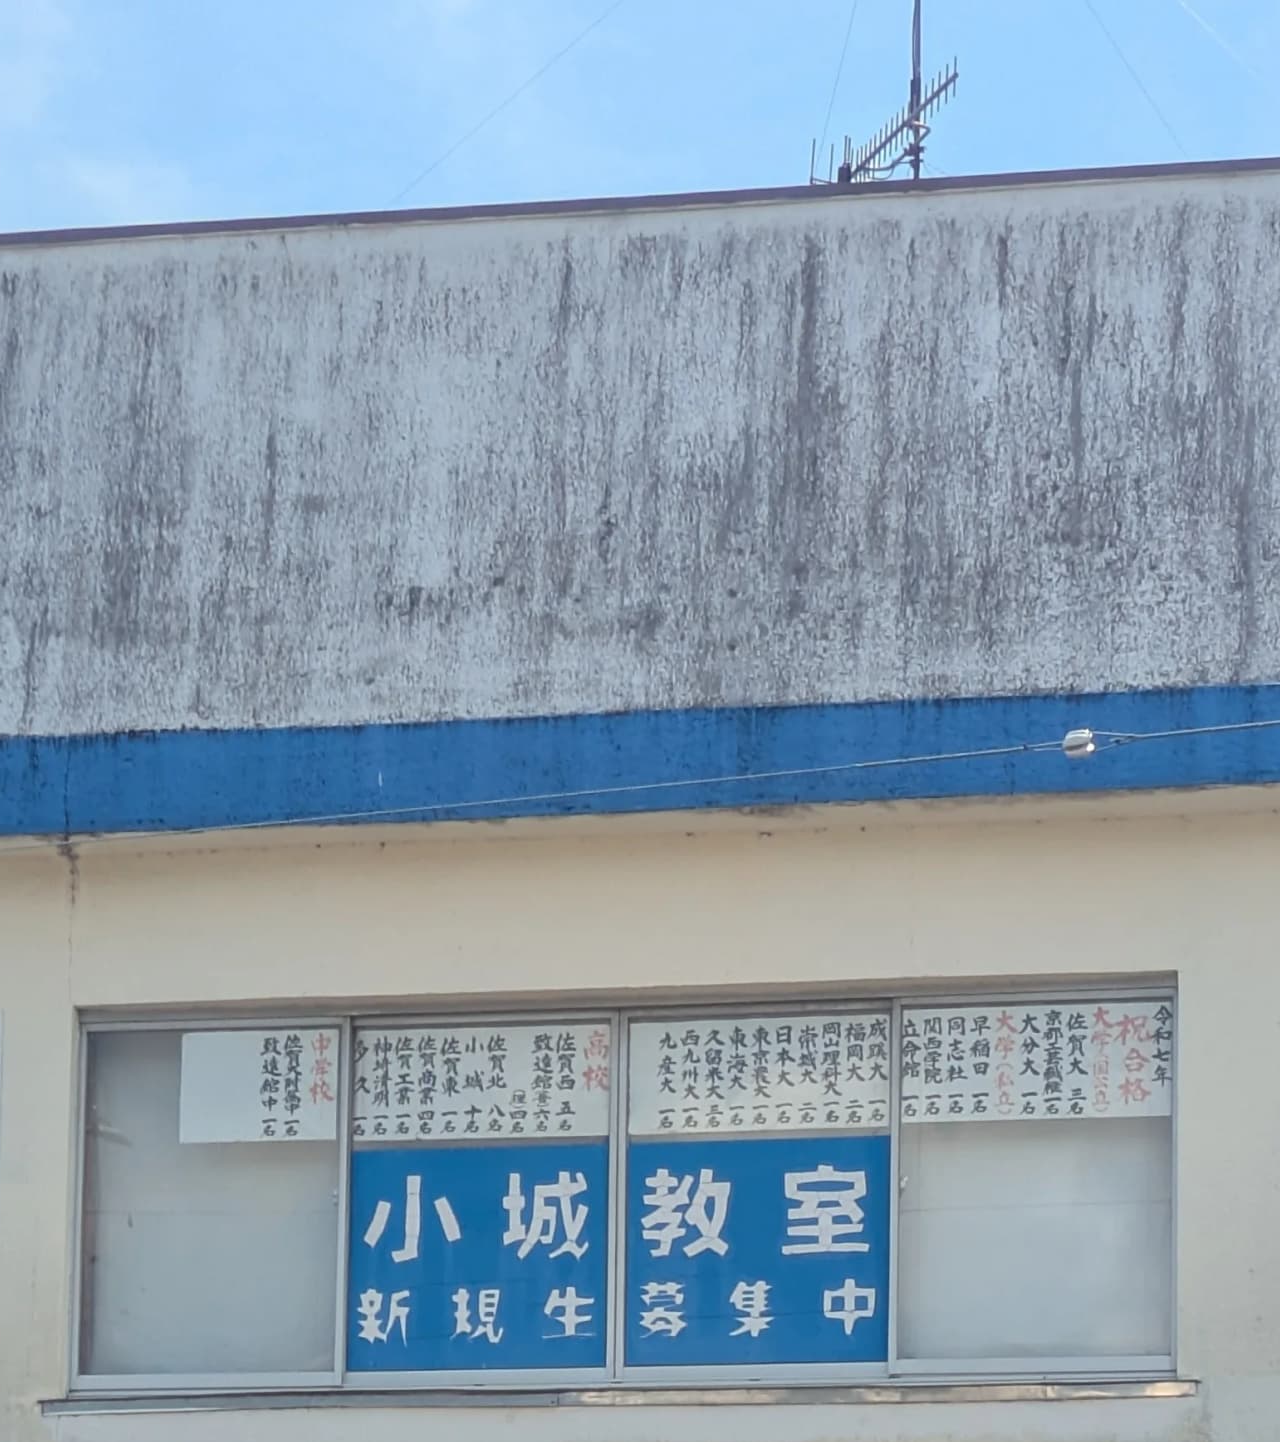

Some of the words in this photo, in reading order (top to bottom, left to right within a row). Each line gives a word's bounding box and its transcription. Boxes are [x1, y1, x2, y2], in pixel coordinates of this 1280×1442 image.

[583, 1031, 610, 1092] 高校
[1151, 1005, 1173, 1086] 令和七年
